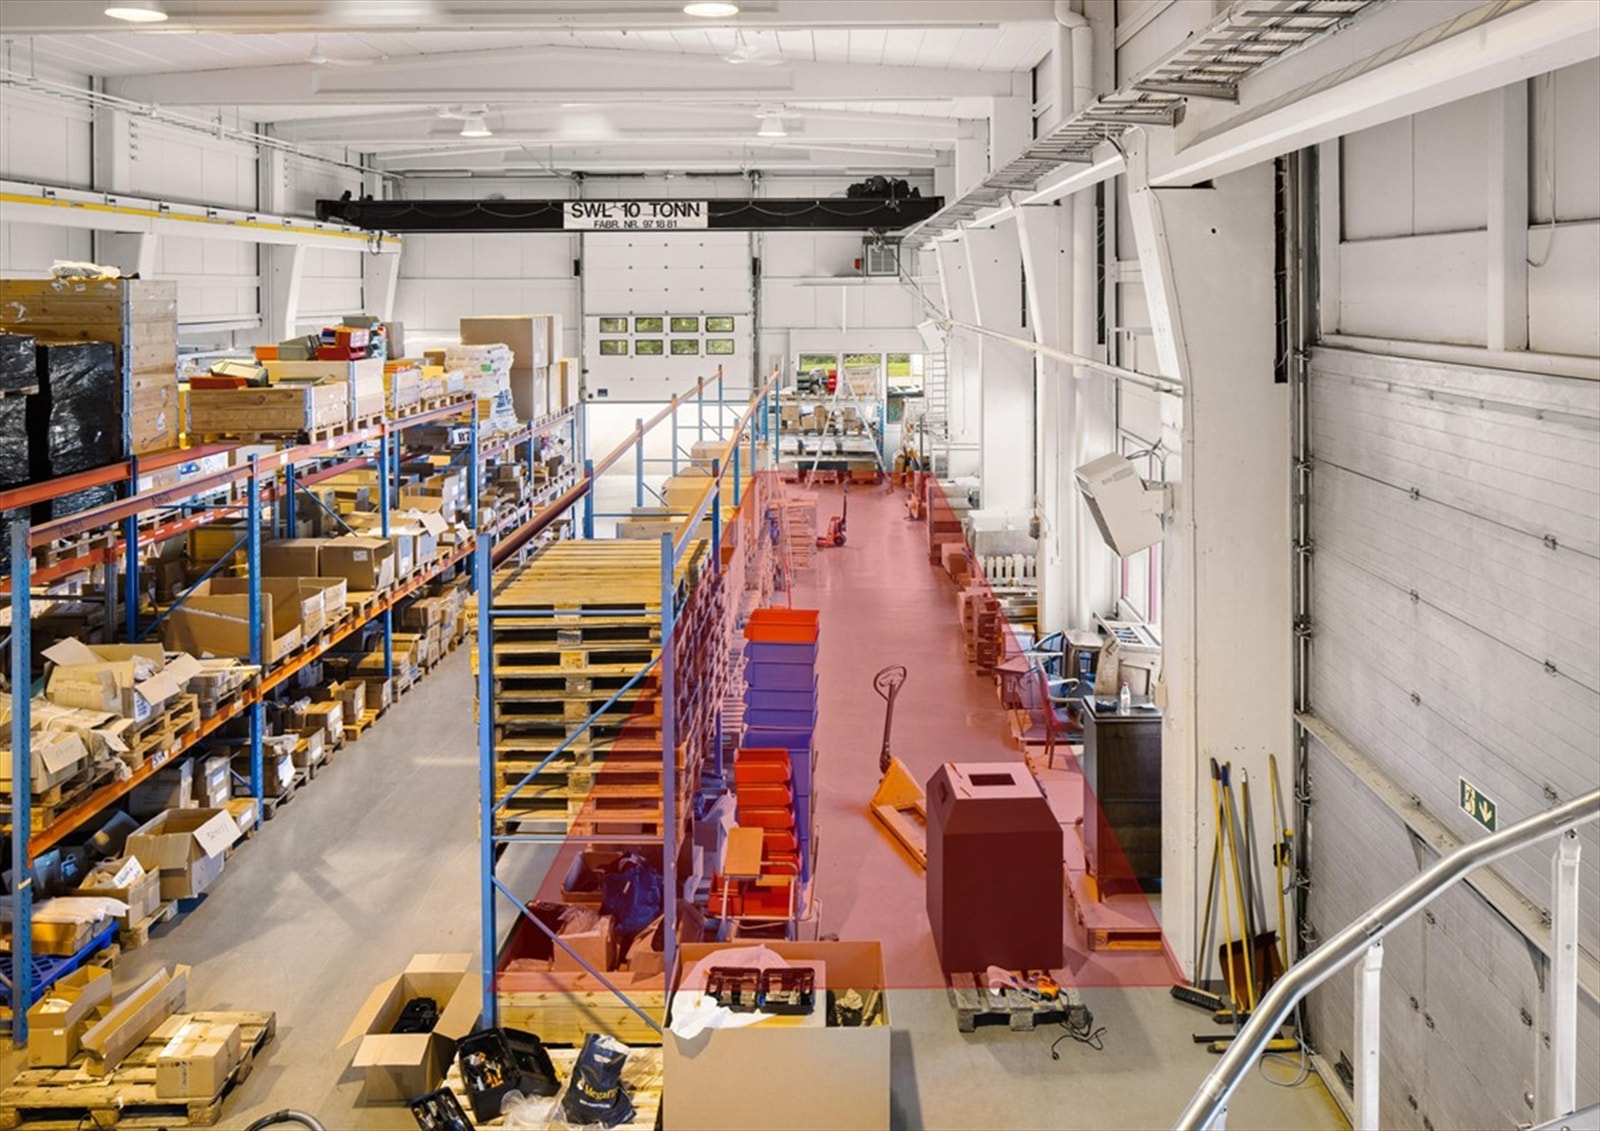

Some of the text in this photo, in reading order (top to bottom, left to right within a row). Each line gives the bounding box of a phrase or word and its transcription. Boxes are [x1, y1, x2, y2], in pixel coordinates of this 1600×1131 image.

[571, 202, 700, 218] SWL 10 TONN
